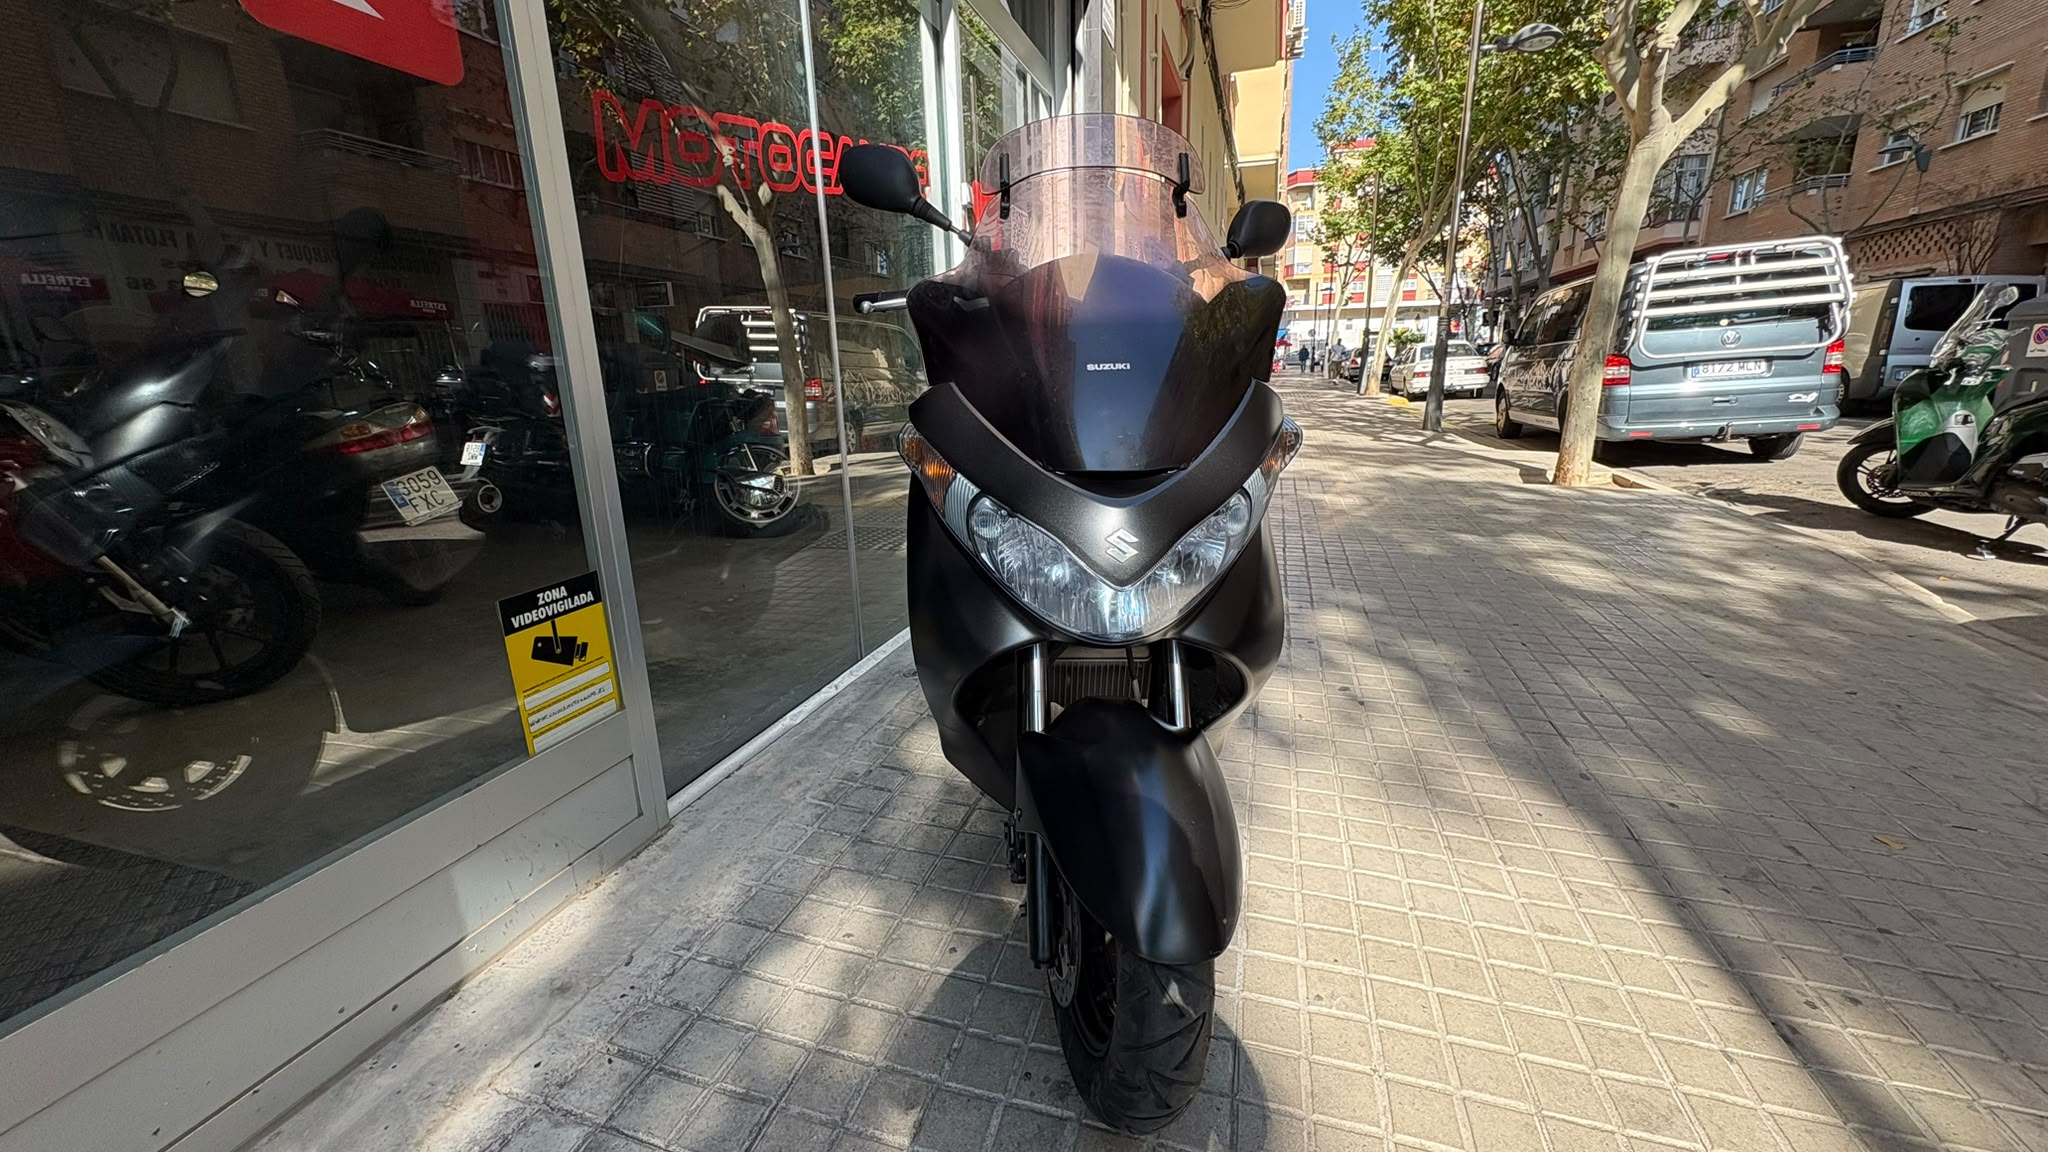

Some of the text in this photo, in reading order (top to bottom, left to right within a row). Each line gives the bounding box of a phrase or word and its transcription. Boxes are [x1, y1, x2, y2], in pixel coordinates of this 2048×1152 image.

[1086, 362, 1131, 371] SUZUKI
[1702, 360, 1762, 374] 8172 MLN
[396, 470, 441, 496] 3059
[408, 489, 445, 514] FXC
[536, 585, 569, 606] ZONA
[511, 590, 595, 629] VIDEOVIGILADA
